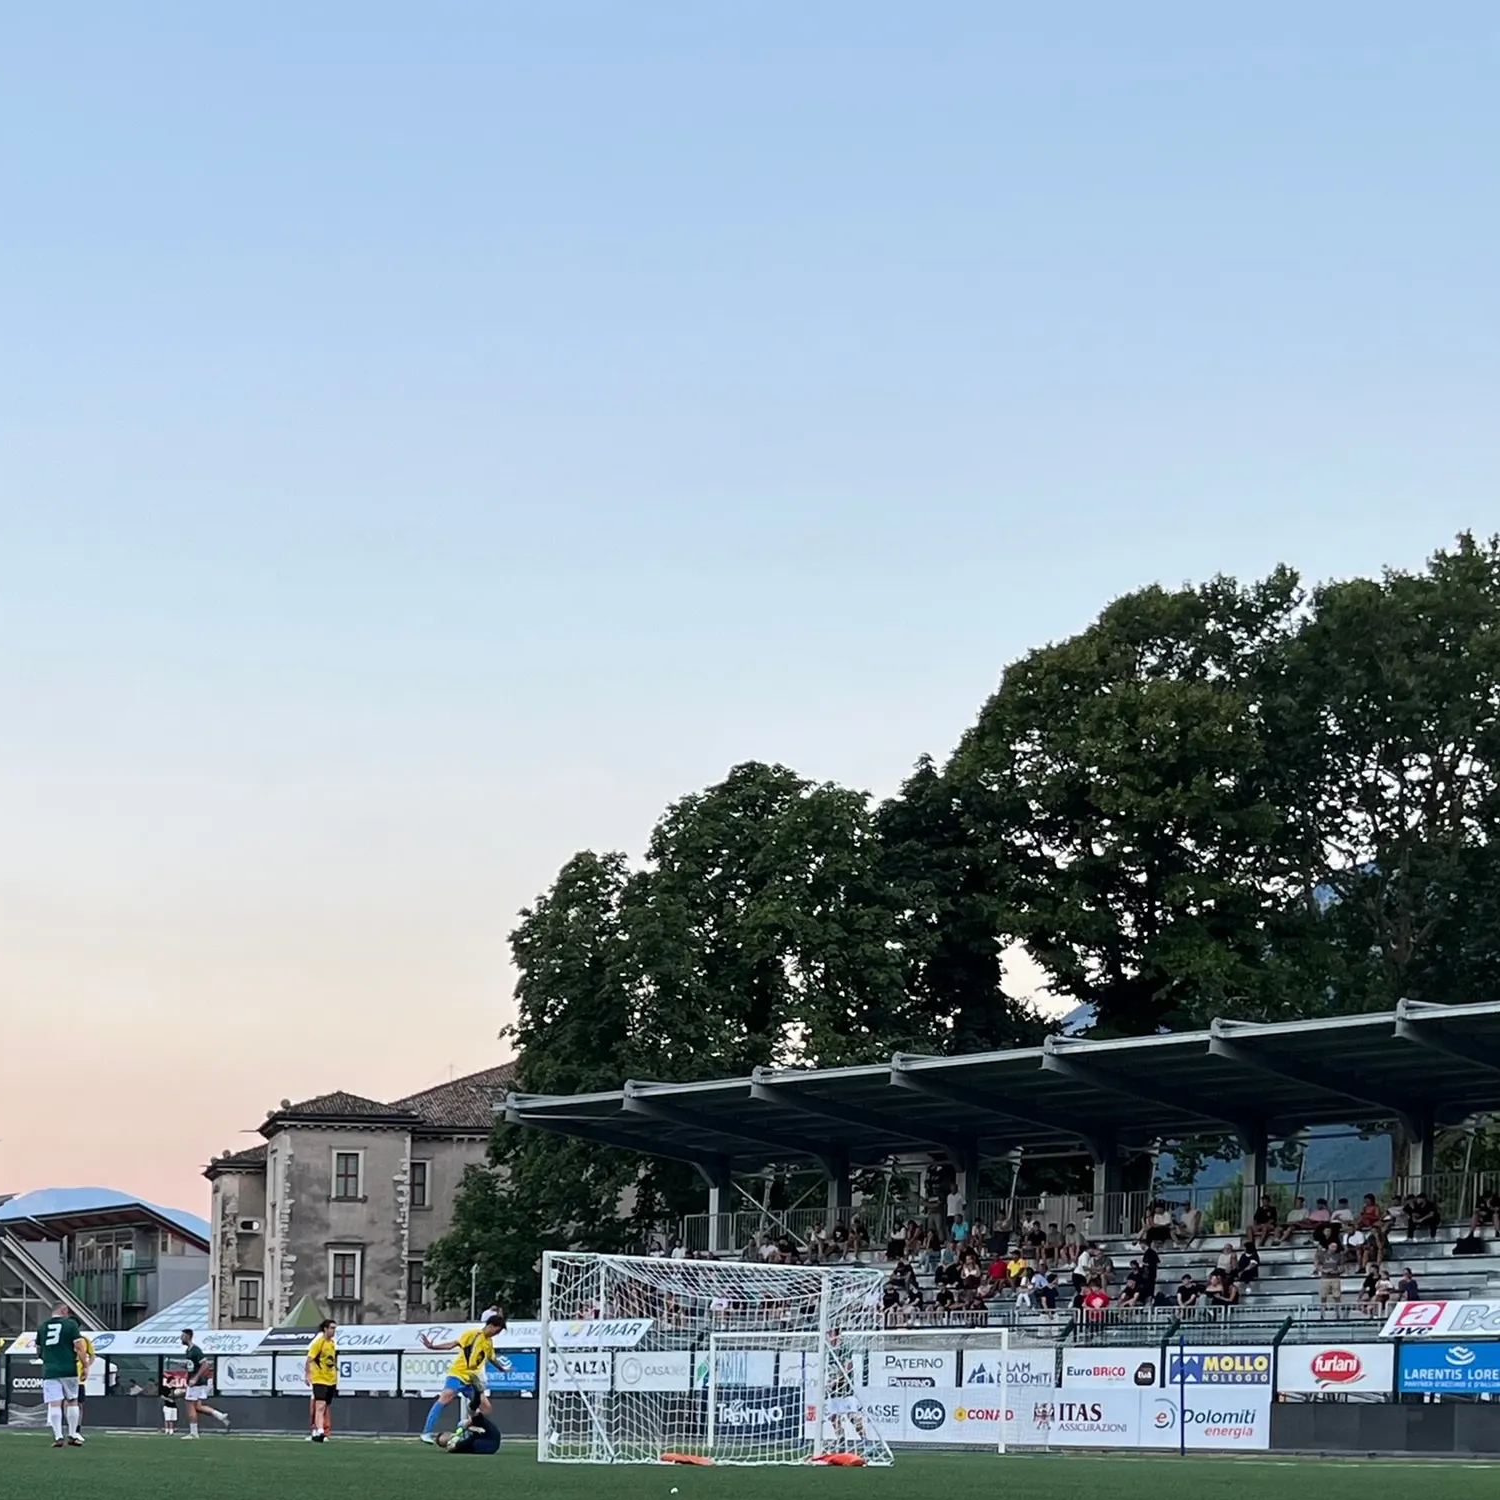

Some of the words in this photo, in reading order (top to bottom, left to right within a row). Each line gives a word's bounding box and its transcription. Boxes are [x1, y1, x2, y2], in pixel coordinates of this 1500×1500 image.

[45, 1323, 62, 1346] 3
[586, 1323, 642, 1336] VIMAR
[337, 1334, 391, 1346] COMAI
[884, 1355, 944, 1370] PATERNO
[1203, 1355, 1269, 1371] MOLLO
[1315, 1355, 1358, 1373] furlani
[1202, 1373, 1268, 1383] NOLEGGIO
[1404, 1368, 1462, 1380] LARENTIS
[717, 1402, 784, 1426] TRENTINO
[914, 1407, 941, 1420] DAO
[1058, 1403, 1102, 1422] ITAS
[1183, 1408, 1257, 1425] Dolomiti
[1058, 1423, 1127, 1433] ASSICURAZIONI
[1204, 1427, 1253, 1439] energia
